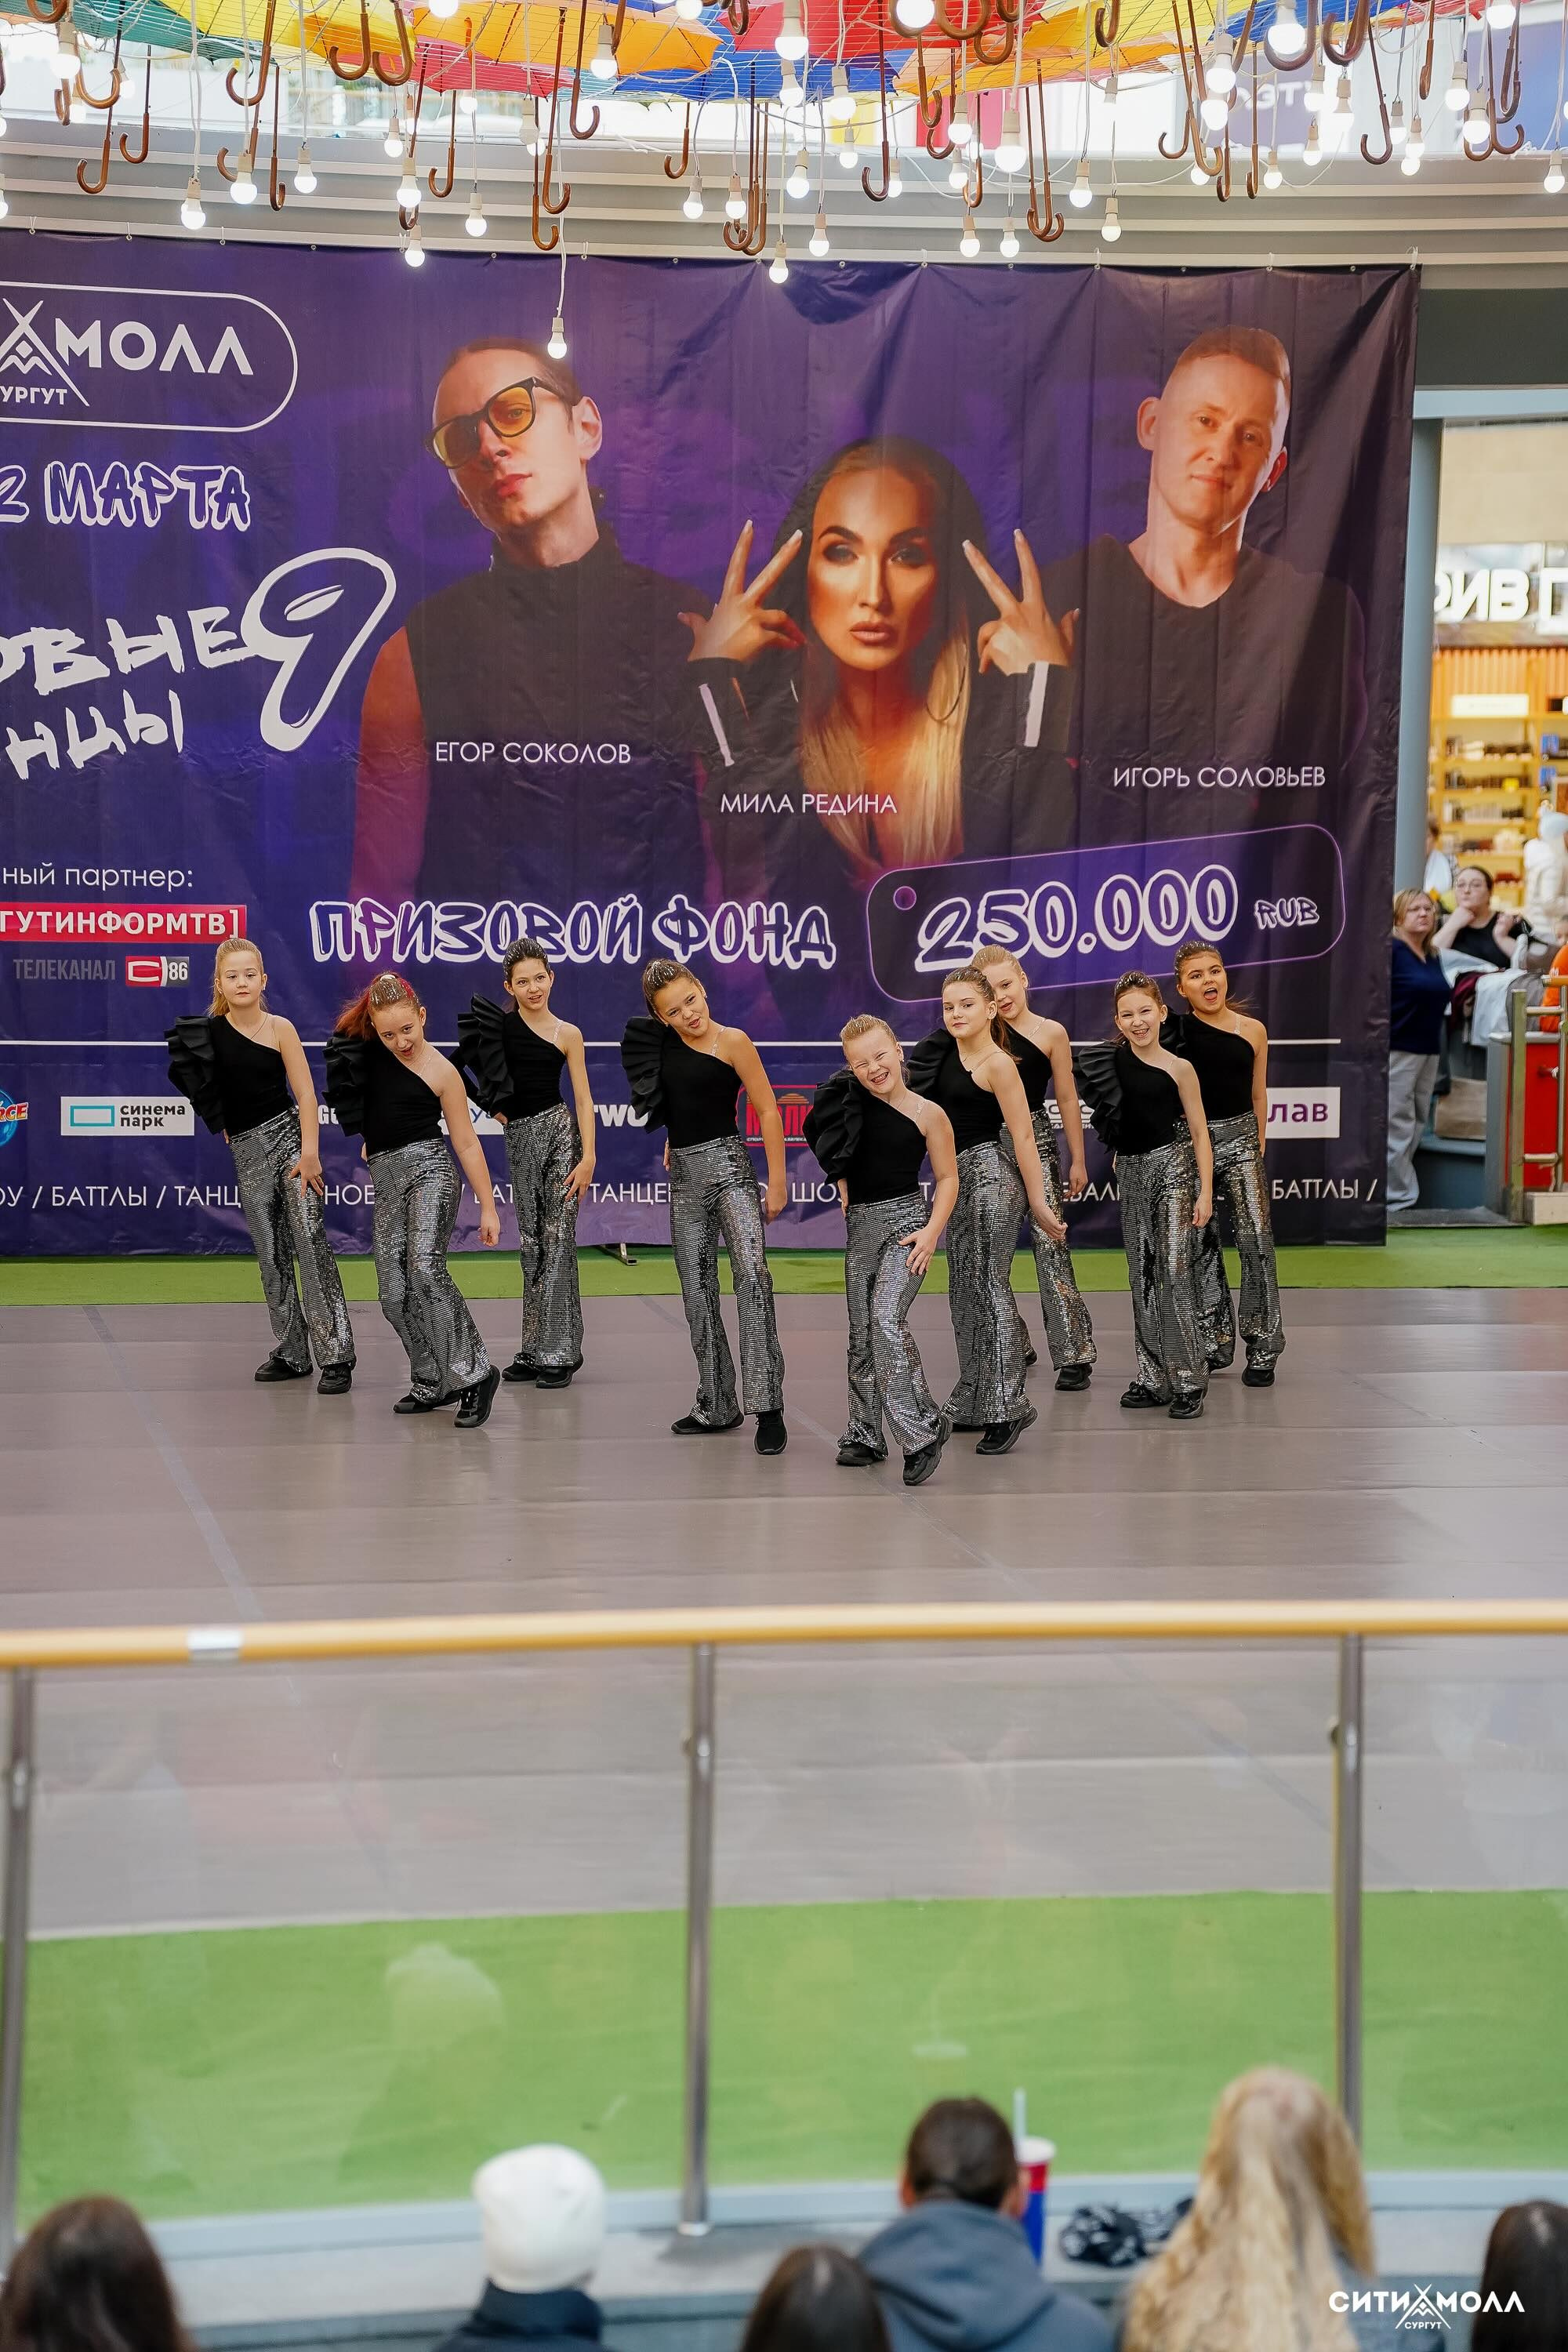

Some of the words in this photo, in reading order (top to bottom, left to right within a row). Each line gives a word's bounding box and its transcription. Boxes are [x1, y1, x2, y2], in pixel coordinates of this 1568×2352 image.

[55, 318, 254, 375] МОЛЛ
[44, 460, 251, 532] МАРТА
[436, 742, 495, 762] ЕГОР
[503, 742, 632, 764] СОКОЛОВ
[1113, 767, 1190, 787] ИГОРЬ
[1197, 766, 1326, 787] СОЛОВЬЕВ
[720, 793, 794, 813] МИЛА
[802, 793, 898, 815] РЕДИНА
[3, 862, 55, 885] ный
[65, 868, 193, 892] партнер:
[914, 864, 1239, 972] 250.000
[1254, 897, 1319, 930] RUB
[309, 894, 642, 964] ПРИЗОВОЙ
[652, 894, 836, 969] ФОНД
[13, 959, 115, 980] ТЕЛЕКАНАЛ
[120, 1105, 185, 1116] синема
[121, 1116, 164, 1131] парк
[52, 1186, 147, 1207] БАТТЛЫ
[589, 1183, 672, 1205] ТАНЦЕ
[792, 1182, 843, 1203] ШО
[1272, 1178, 1359, 1200] БАТТЛЫ
